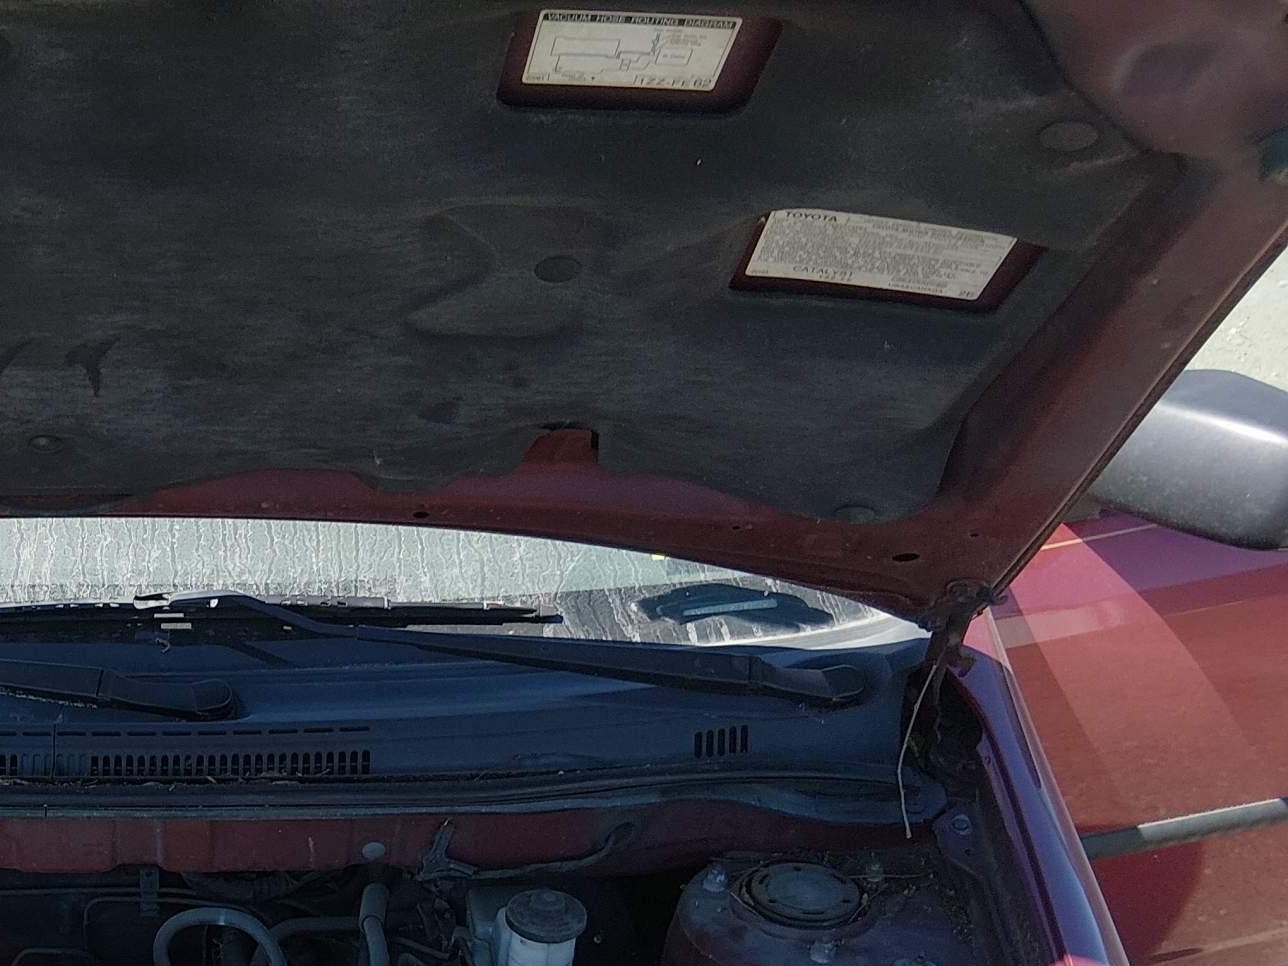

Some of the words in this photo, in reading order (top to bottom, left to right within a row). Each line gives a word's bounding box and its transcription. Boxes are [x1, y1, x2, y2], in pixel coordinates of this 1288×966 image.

[546, 13, 592, 22] VACUUM
[596, 14, 624, 24] HOSE
[631, 16, 679, 26] ROUTING
[683, 18, 734, 29] DIAGRAM
[784, 211, 838, 223] TOYOTA
